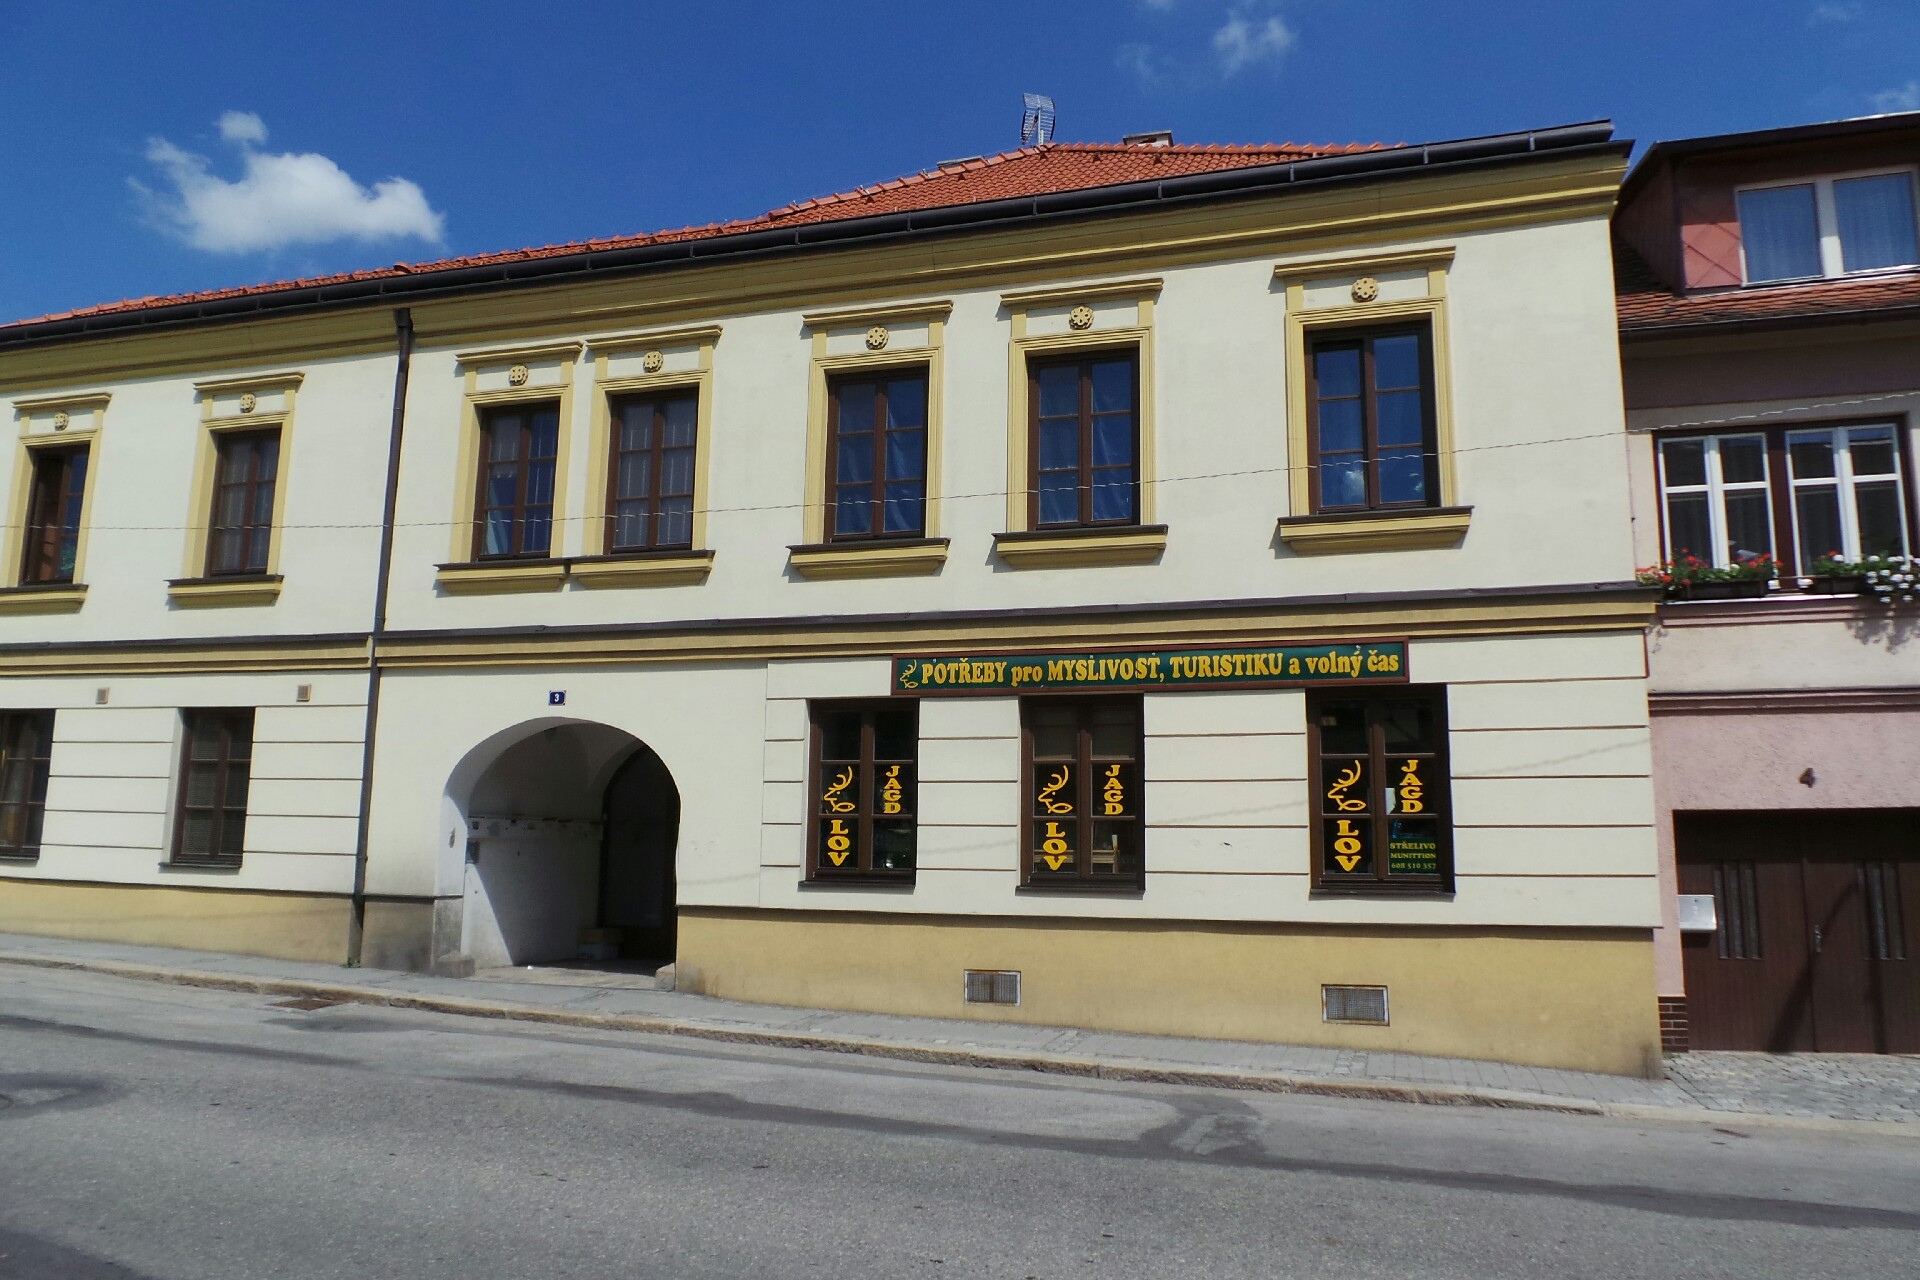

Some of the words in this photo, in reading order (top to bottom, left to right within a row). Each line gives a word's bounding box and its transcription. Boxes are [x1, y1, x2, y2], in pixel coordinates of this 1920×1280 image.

[922, 658, 1008, 684] POTŘEBY
[1011, 665, 1042, 686] pro
[1047, 657, 1165, 682] MYSLIVOST,
[1170, 653, 1284, 678] TURISTIKU
[1289, 657, 1301, 675] a
[1305, 650, 1363, 678] volný
[1367, 650, 1399, 672] čas
[554, 693, 560, 702] 3
[883, 765, 902, 814] JAGD
[1103, 764, 1124, 815] JAGD
[1399, 759, 1423, 813] JAGD
[827, 819, 850, 867] LOV
[1042, 822, 1068, 871] LOV
[1334, 819, 1362, 872] LOV
[1390, 841, 1436, 850] STŘELIVO
